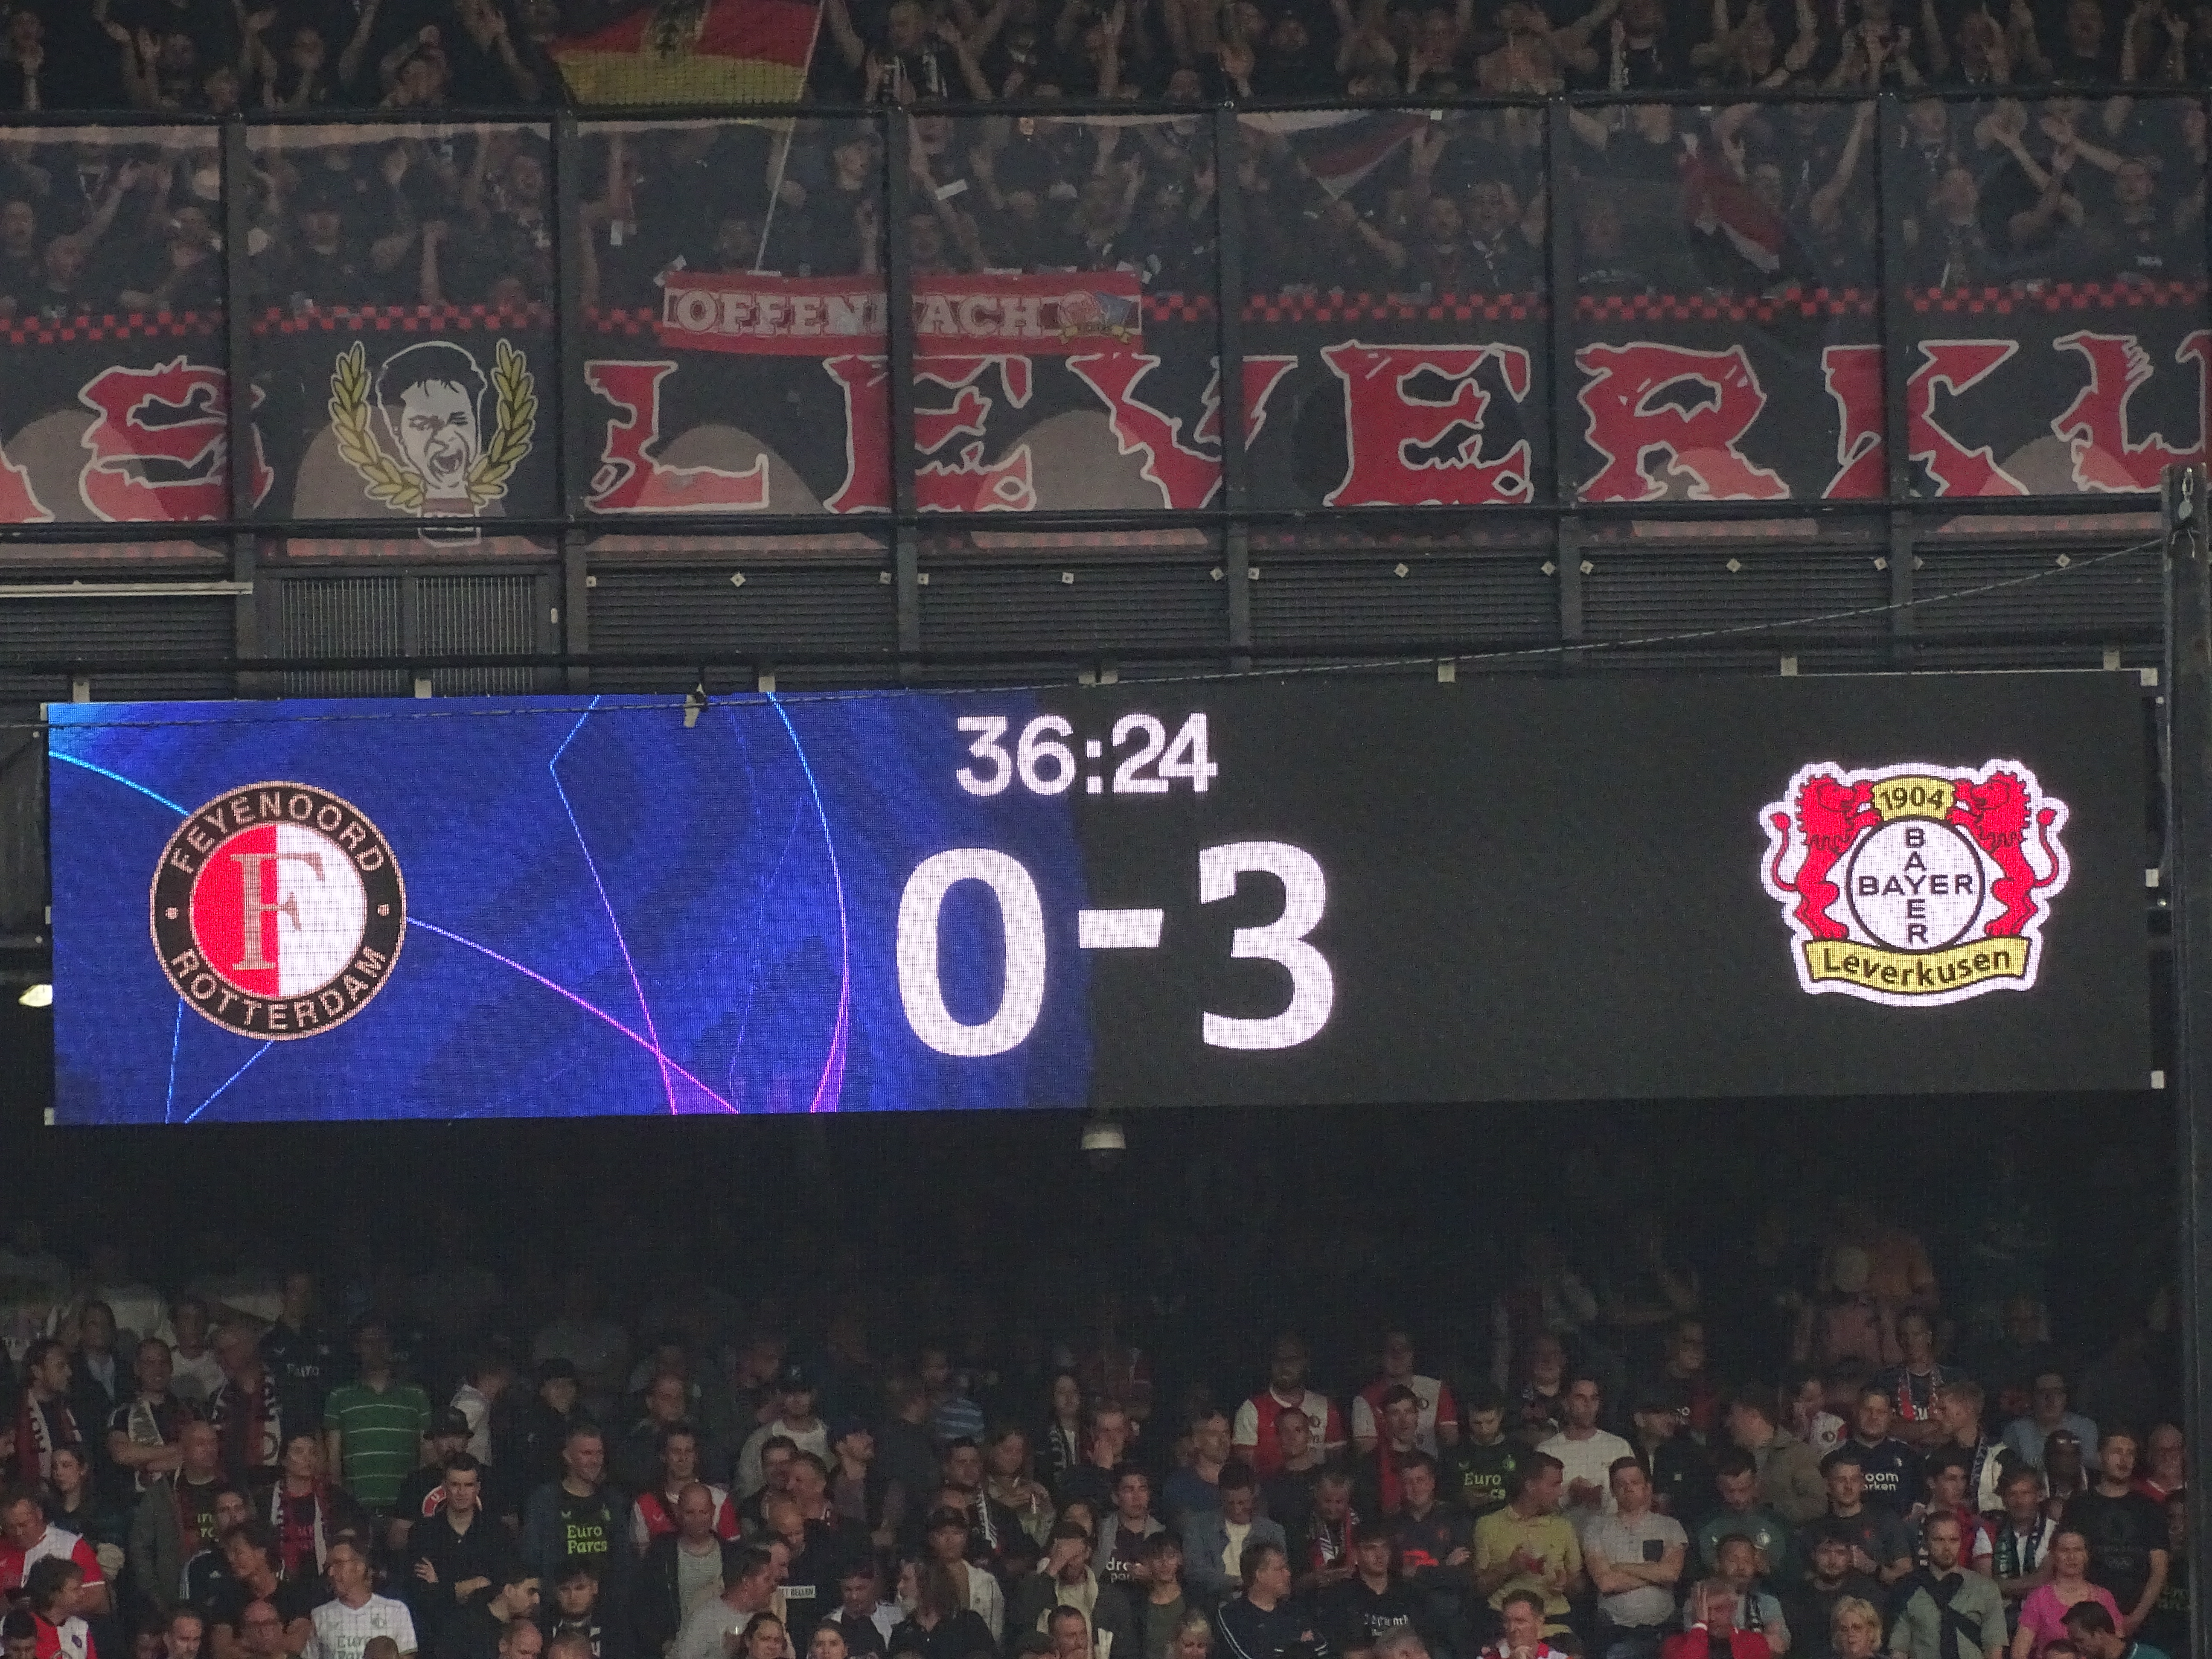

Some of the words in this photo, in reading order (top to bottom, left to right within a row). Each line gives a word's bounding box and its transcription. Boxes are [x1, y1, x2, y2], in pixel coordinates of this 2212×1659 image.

[955, 712, 1219, 796] 36:24
[1880, 786, 1944, 811] 1904
[170, 792, 385, 875] FEYENOORD
[1858, 875, 1974, 896] BAYER
[1904, 828, 1929, 944] BAYER
[1823, 948, 2011, 987] Leverkusen
[171, 946, 386, 1030] ROTTERDAM
[1464, 1472, 1502, 1486] Euro
[1862, 1473, 1899, 1483] oom
[1863, 1481, 1896, 1492] rken
[568, 1525, 601, 1539] Euro
[568, 1540, 606, 1554] Parcs
[336, 1635, 372, 1648] Eur
